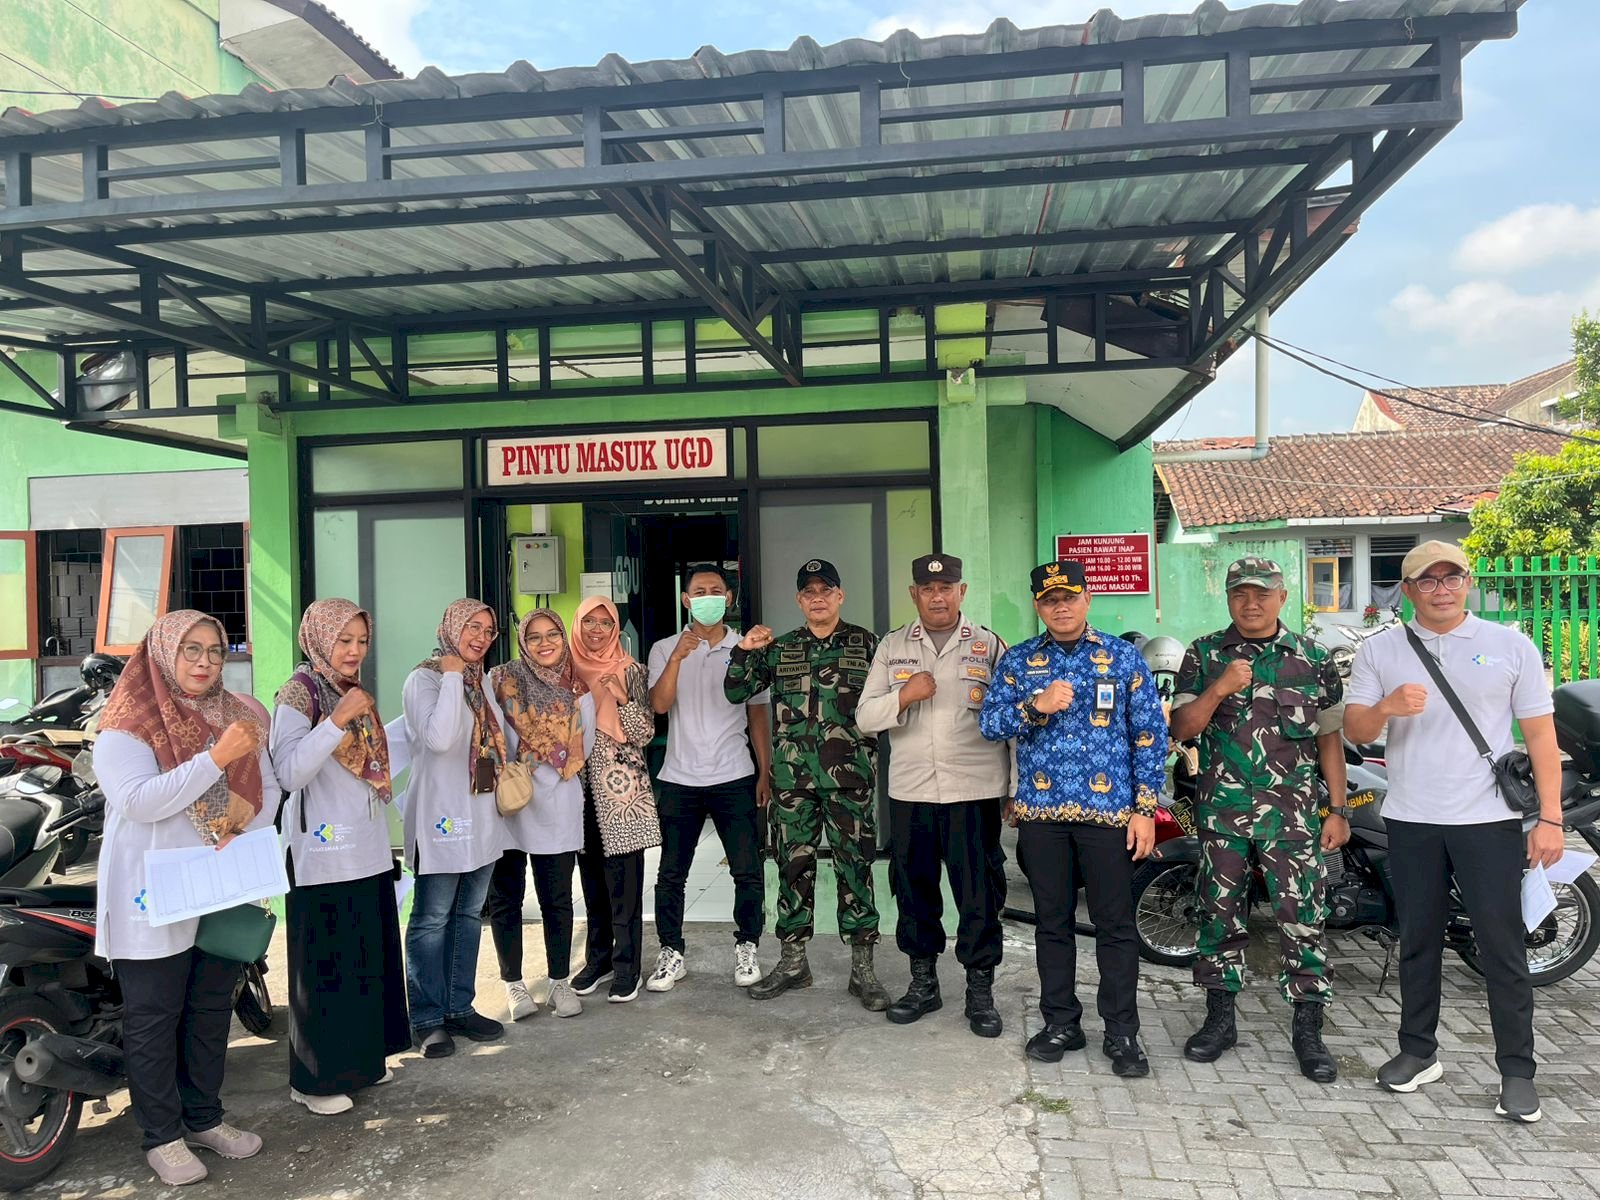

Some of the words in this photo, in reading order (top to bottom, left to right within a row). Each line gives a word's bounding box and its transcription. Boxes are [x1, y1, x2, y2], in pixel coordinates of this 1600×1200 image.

[501, 444, 570, 477] PINTU
[576, 441, 657, 473] MASUK
[664, 437, 714, 469] UGD
[1093, 537, 1125, 545] KUNJUNG
